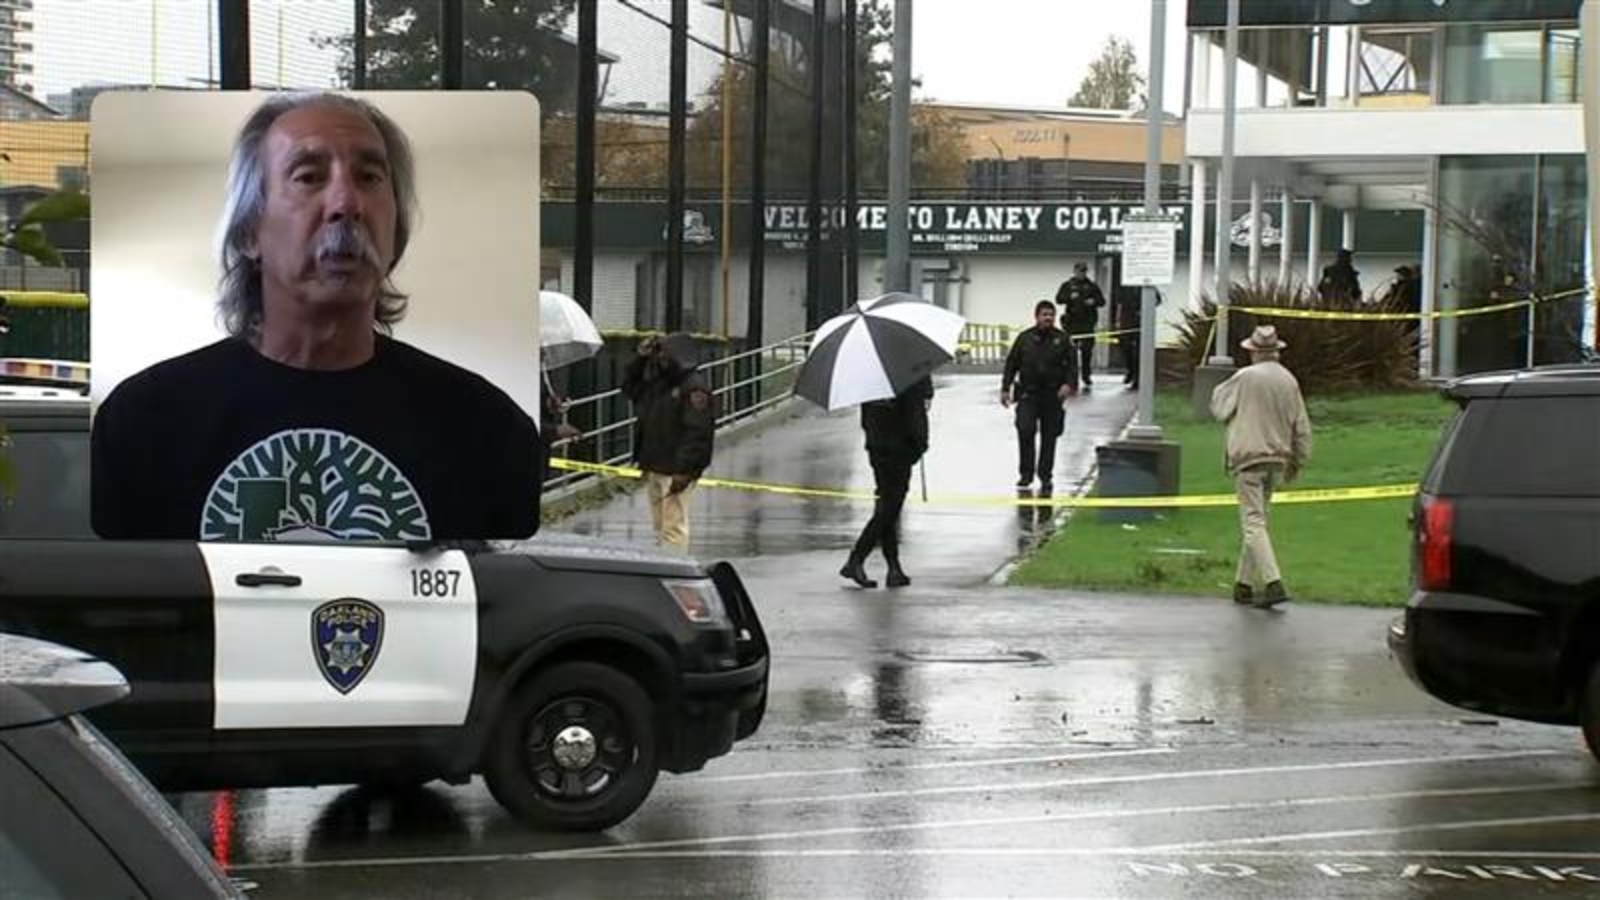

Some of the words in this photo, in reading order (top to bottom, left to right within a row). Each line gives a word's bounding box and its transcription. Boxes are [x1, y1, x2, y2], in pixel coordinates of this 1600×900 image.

[946, 206, 1043, 230] LANEY
[1055, 206, 1184, 230] COLLE
[410, 569, 461, 597] 1887
[319, 605, 377, 623] OAKLAND
[327, 614, 368, 629] POLICE
[1125, 862, 1258, 878] NO
